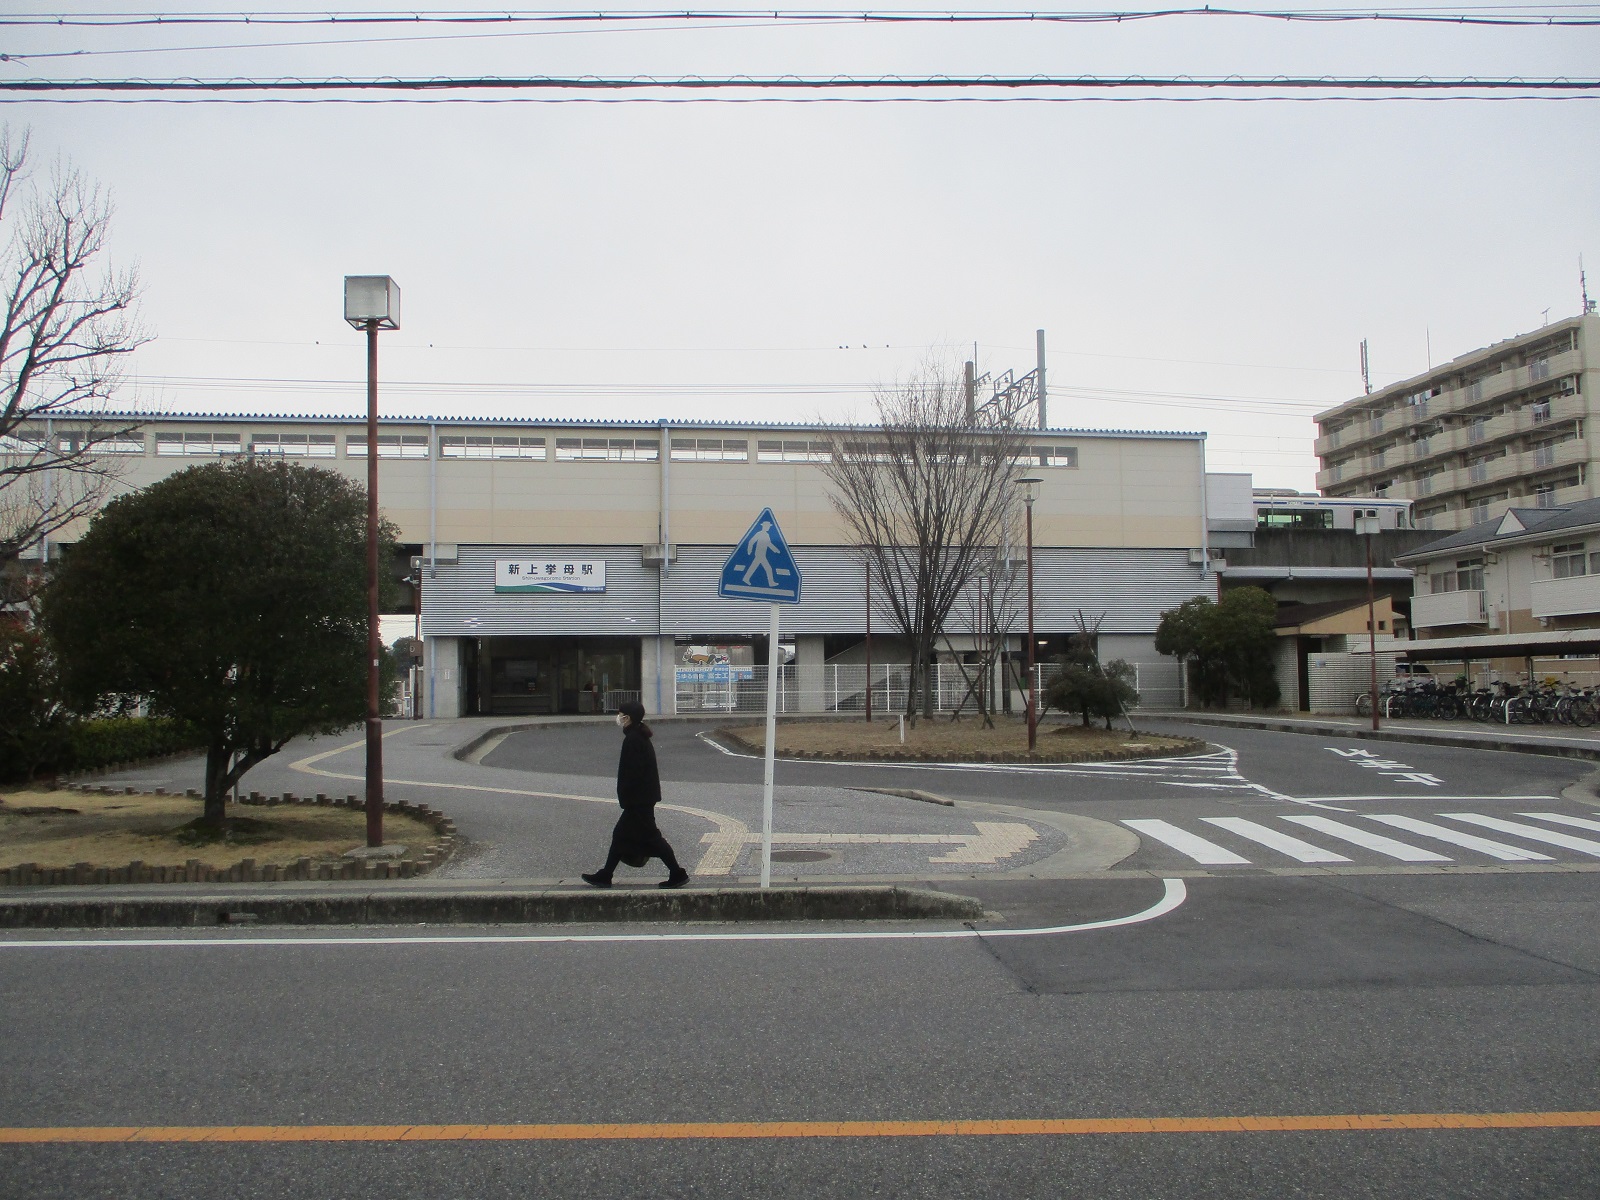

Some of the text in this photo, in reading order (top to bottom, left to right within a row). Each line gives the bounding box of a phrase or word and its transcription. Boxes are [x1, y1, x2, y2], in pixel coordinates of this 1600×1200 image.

[508, 563, 593, 575] 新上挙母駅
